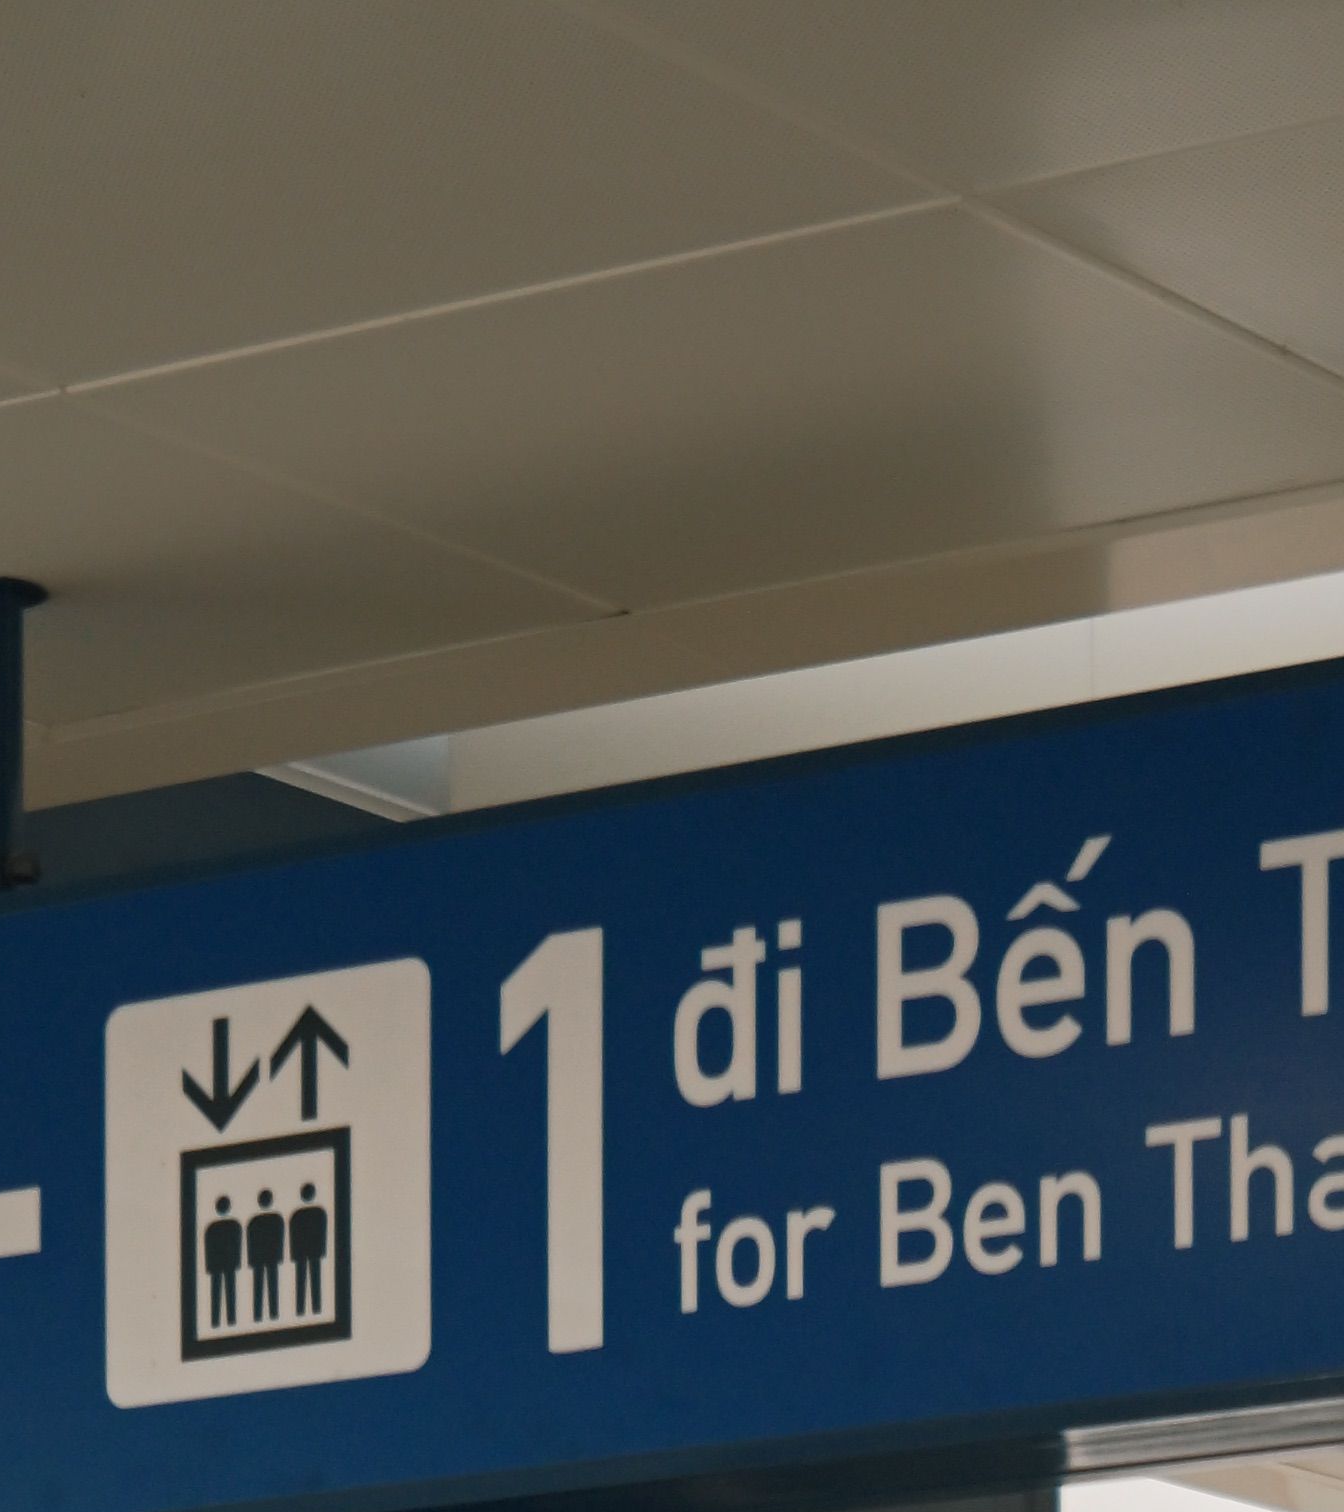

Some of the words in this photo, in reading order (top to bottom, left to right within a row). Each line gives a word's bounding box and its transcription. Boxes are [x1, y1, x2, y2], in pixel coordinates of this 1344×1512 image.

[497, 926, 606, 1356] 1
[670, 919, 807, 1109] đi
[874, 832, 1201, 1082] Bến
[670, 1190, 836, 1316] for
[878, 1158, 1105, 1292] Ben
